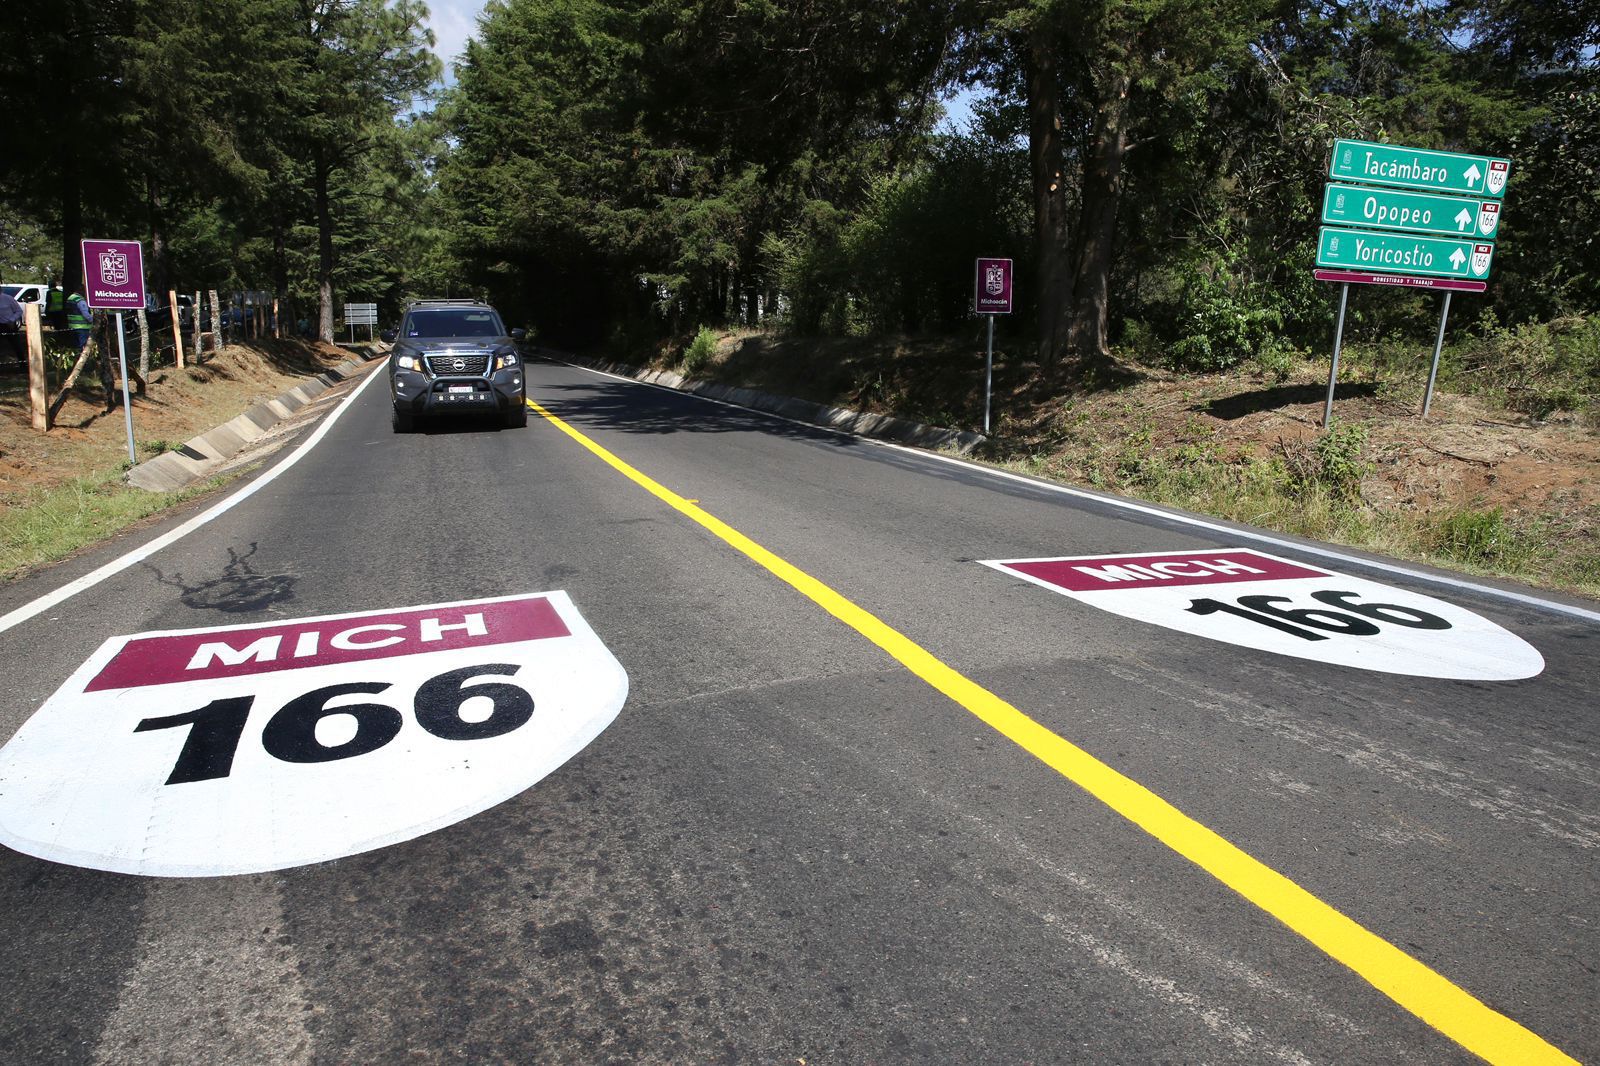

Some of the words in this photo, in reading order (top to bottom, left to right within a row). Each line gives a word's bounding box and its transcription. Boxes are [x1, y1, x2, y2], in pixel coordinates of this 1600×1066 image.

[1364, 152, 1447, 183] Tacámbaro
[1490, 172, 1503, 186] 166
[1363, 196, 1432, 227] Opopeo
[1482, 213, 1494, 227] 166
[1355, 238, 1433, 267] Yoricostio
[1474, 255, 1487, 268] 166
[1372, 276, 1404, 284] HONESTIDAD
[95, 290, 138, 298] Michoacán
[1072, 559, 1267, 583] MICH
[1183, 590, 1453, 642] 166
[185, 612, 488, 670] MICH
[133, 663, 535, 785] 166
